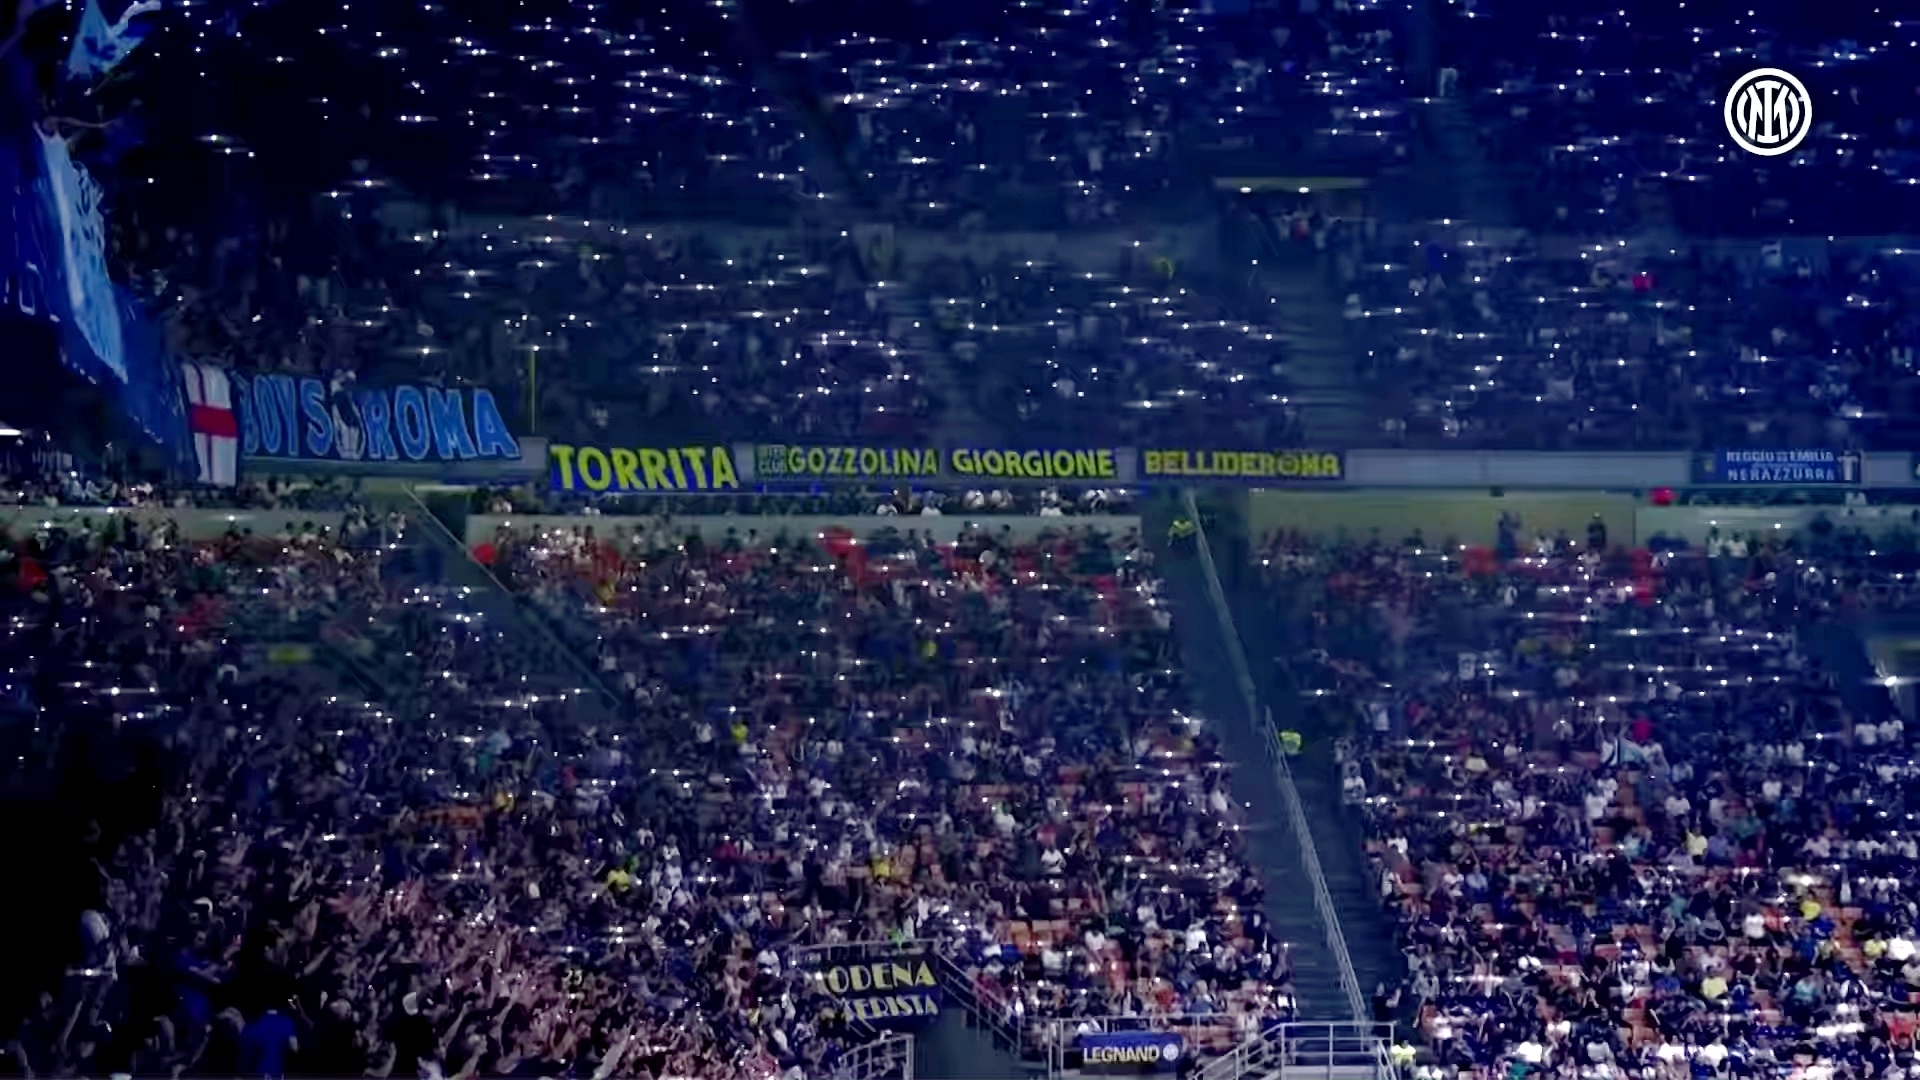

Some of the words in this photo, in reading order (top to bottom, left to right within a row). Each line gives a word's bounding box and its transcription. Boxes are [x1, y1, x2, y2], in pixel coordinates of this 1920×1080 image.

[361, 384, 521, 460] ROMA
[550, 444, 739, 491] TORRITA
[788, 446, 937, 475] GOZZOLINA
[952, 449, 1115, 477] GIORGIONE
[1728, 468, 1834, 480] NERAZZURRA
[828, 961, 937, 993] ODENA
